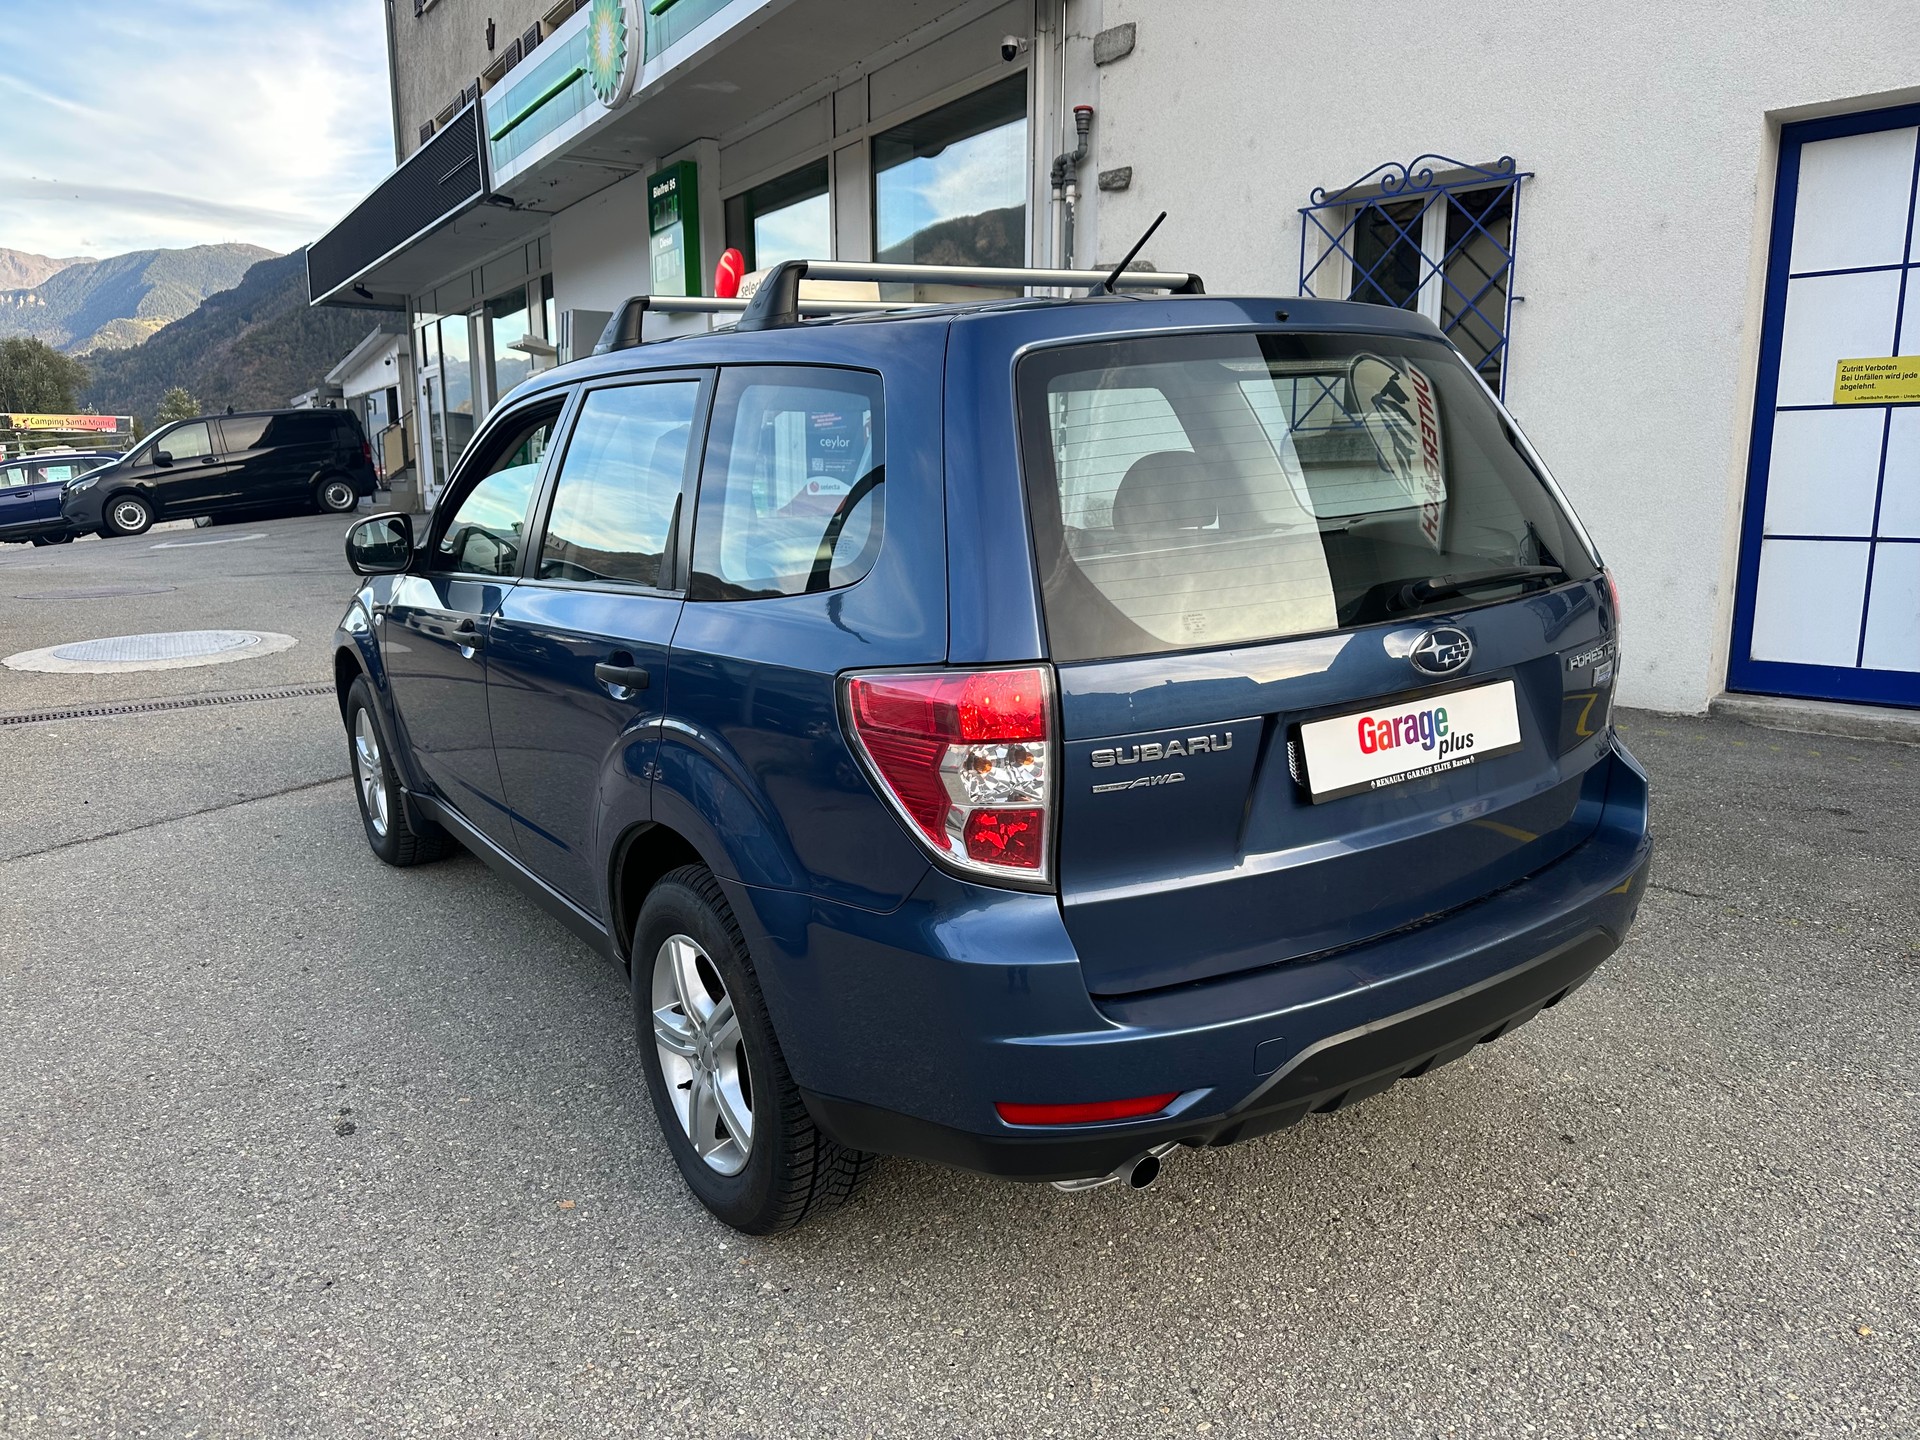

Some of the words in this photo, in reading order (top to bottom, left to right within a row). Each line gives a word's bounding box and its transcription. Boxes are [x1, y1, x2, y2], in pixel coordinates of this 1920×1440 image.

[1842, 365, 1863, 373] Zutritt
[1865, 364, 1897, 372] Verboten
[1841, 374, 1852, 382] Bei
[1854, 373, 1883, 381] Unfällen
[1885, 372, 1900, 380] wird
[1901, 371, 1918, 380] jede
[1840, 383, 1876, 391] abgelehnt.
[30, 417, 64, 426] Camping
[65, 418, 87, 426] Santa
[88, 419, 116, 427] Monica
[820, 435, 850, 449] ceylor
[1358, 707, 1449, 754] Garage
[1090, 732, 1233, 768] SUBARU
[1438, 732, 1474, 759] plus
[1128, 772, 1186, 789] AWD
[1376, 773, 1405, 788] RENAULT
[1407, 766, 1433, 780] GARAGE
[1434, 762, 1452, 773] ELITE
[1452, 758, 1470, 769] Raron
